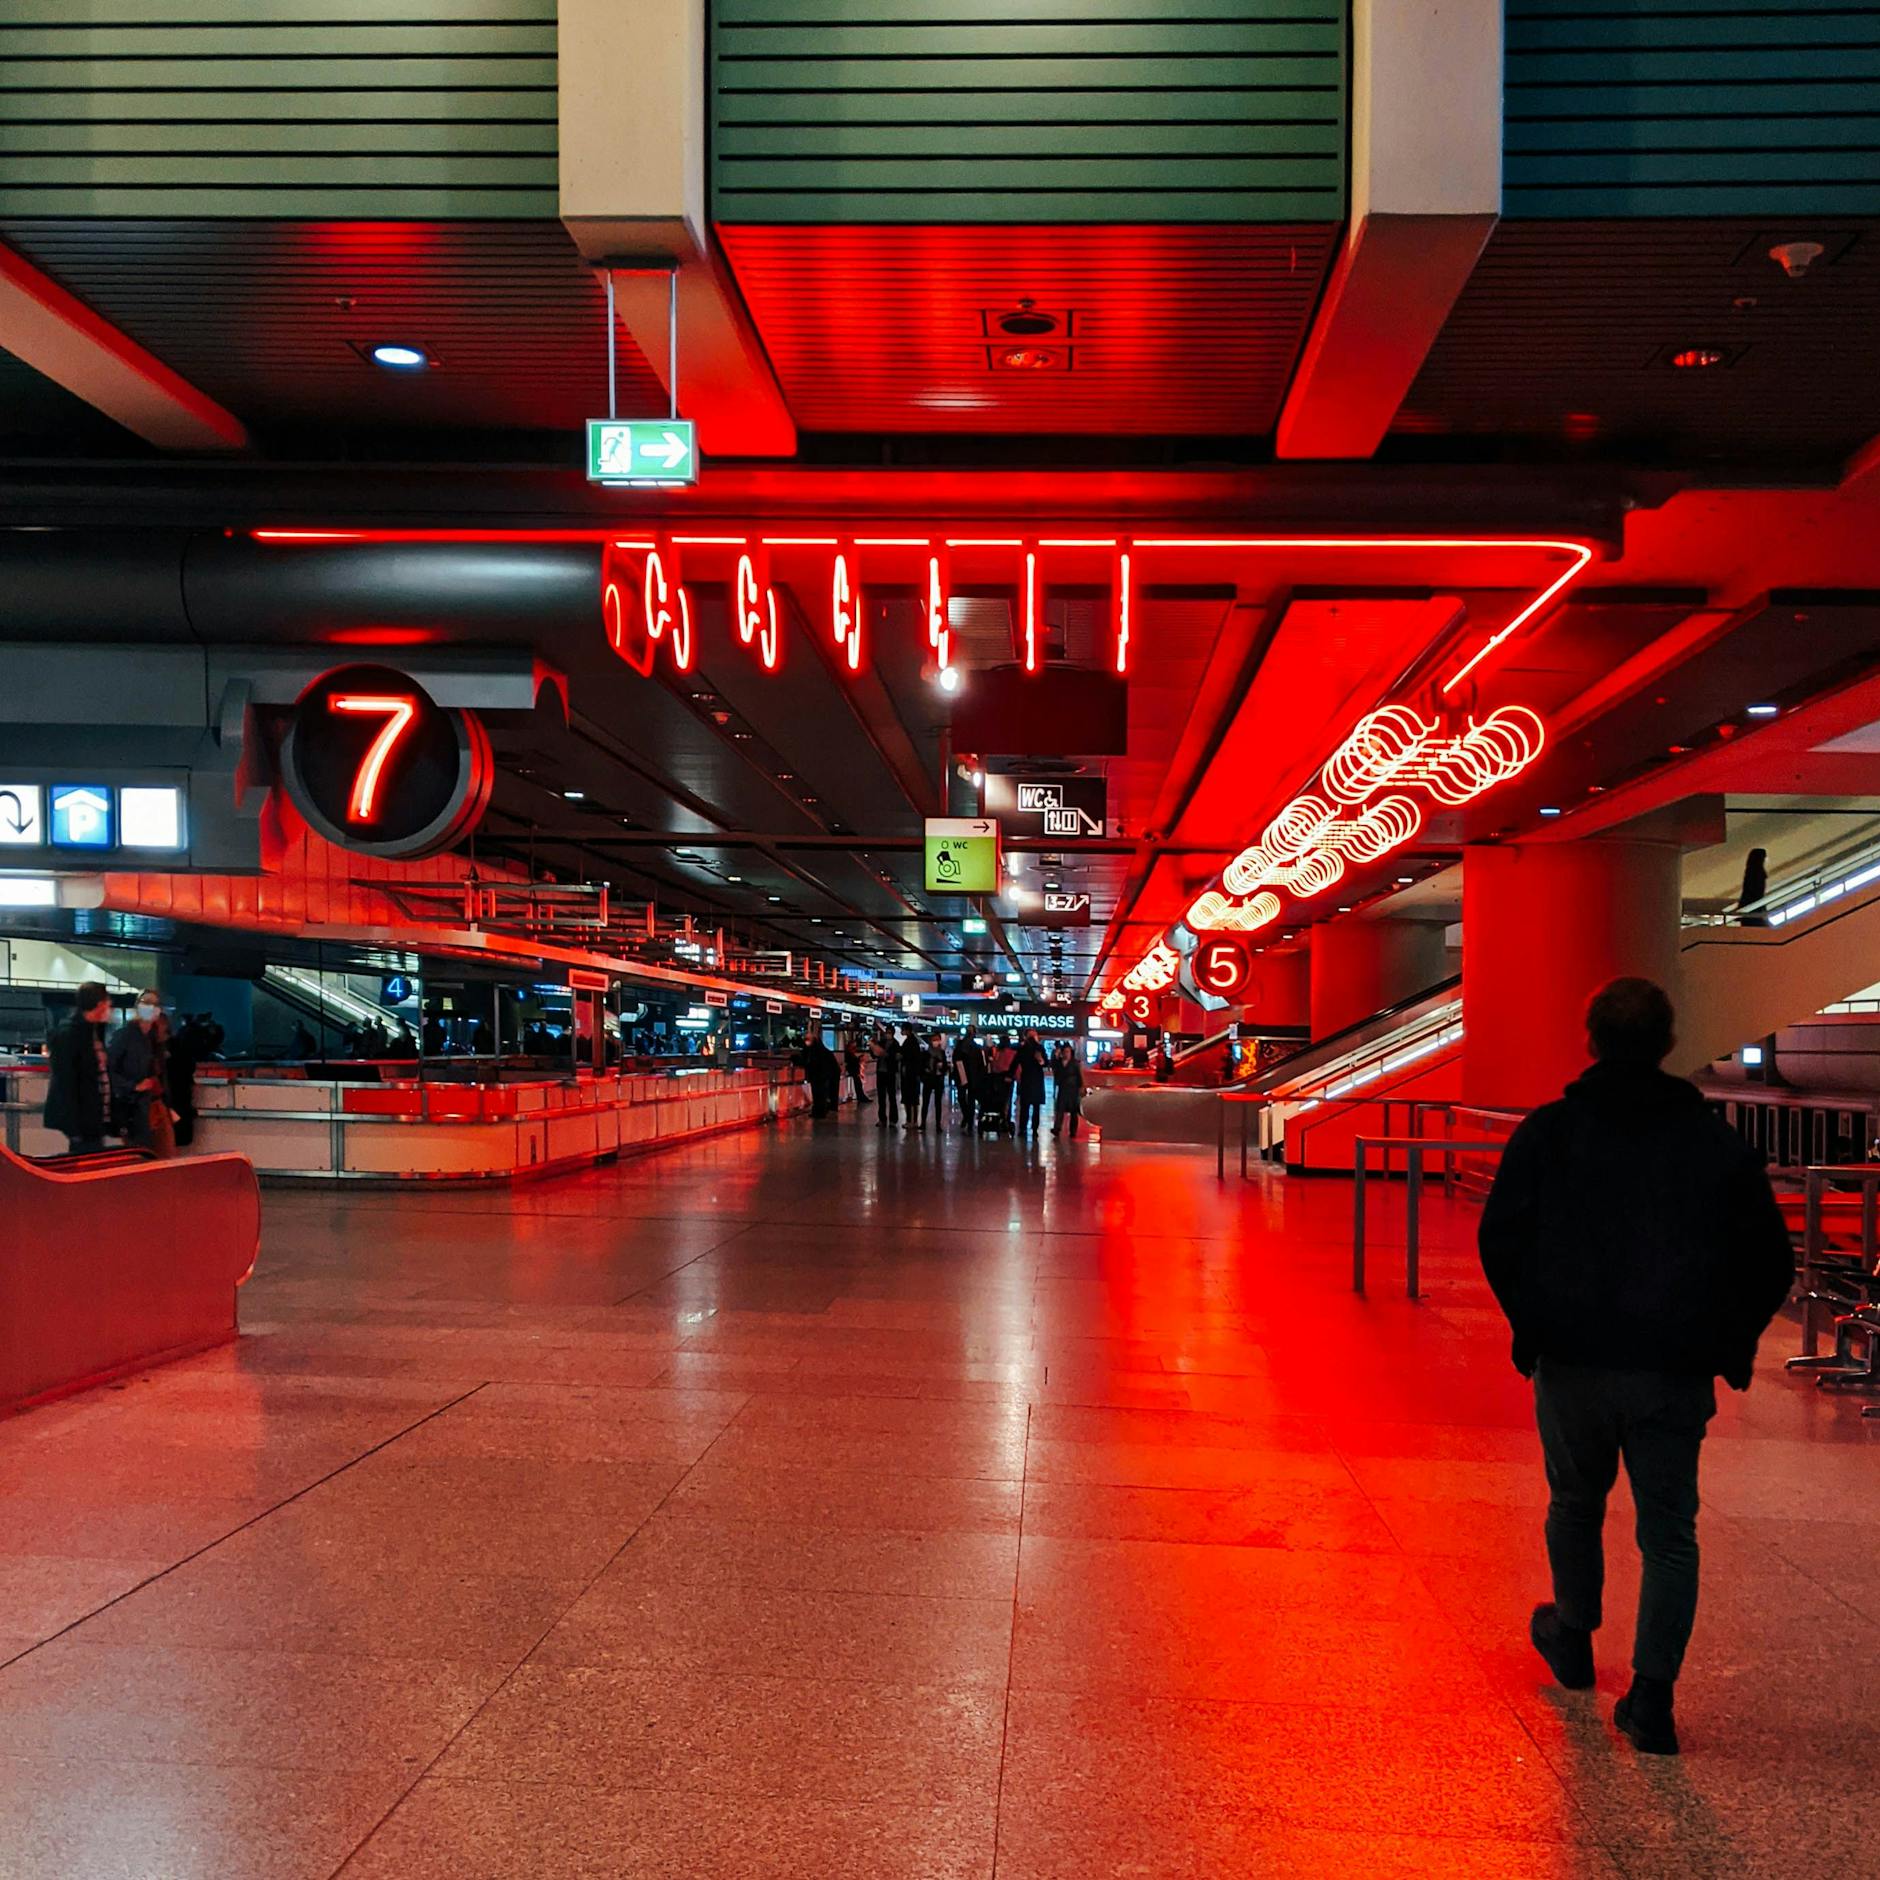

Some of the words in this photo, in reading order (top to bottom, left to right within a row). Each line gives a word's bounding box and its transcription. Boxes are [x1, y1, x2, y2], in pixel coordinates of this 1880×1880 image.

[329, 695, 416, 823] 7
[1021, 787, 1045, 808] WC
[68, 804, 97, 842] P
[953, 841, 968, 849] WC
[1208, 946, 1238, 987] 5
[387, 977, 403, 998] 4
[1133, 996, 1150, 1019] 3
[978, 1013, 1075, 1028] KANTSTRASSE
[1110, 1012, 1118, 1028] 1
